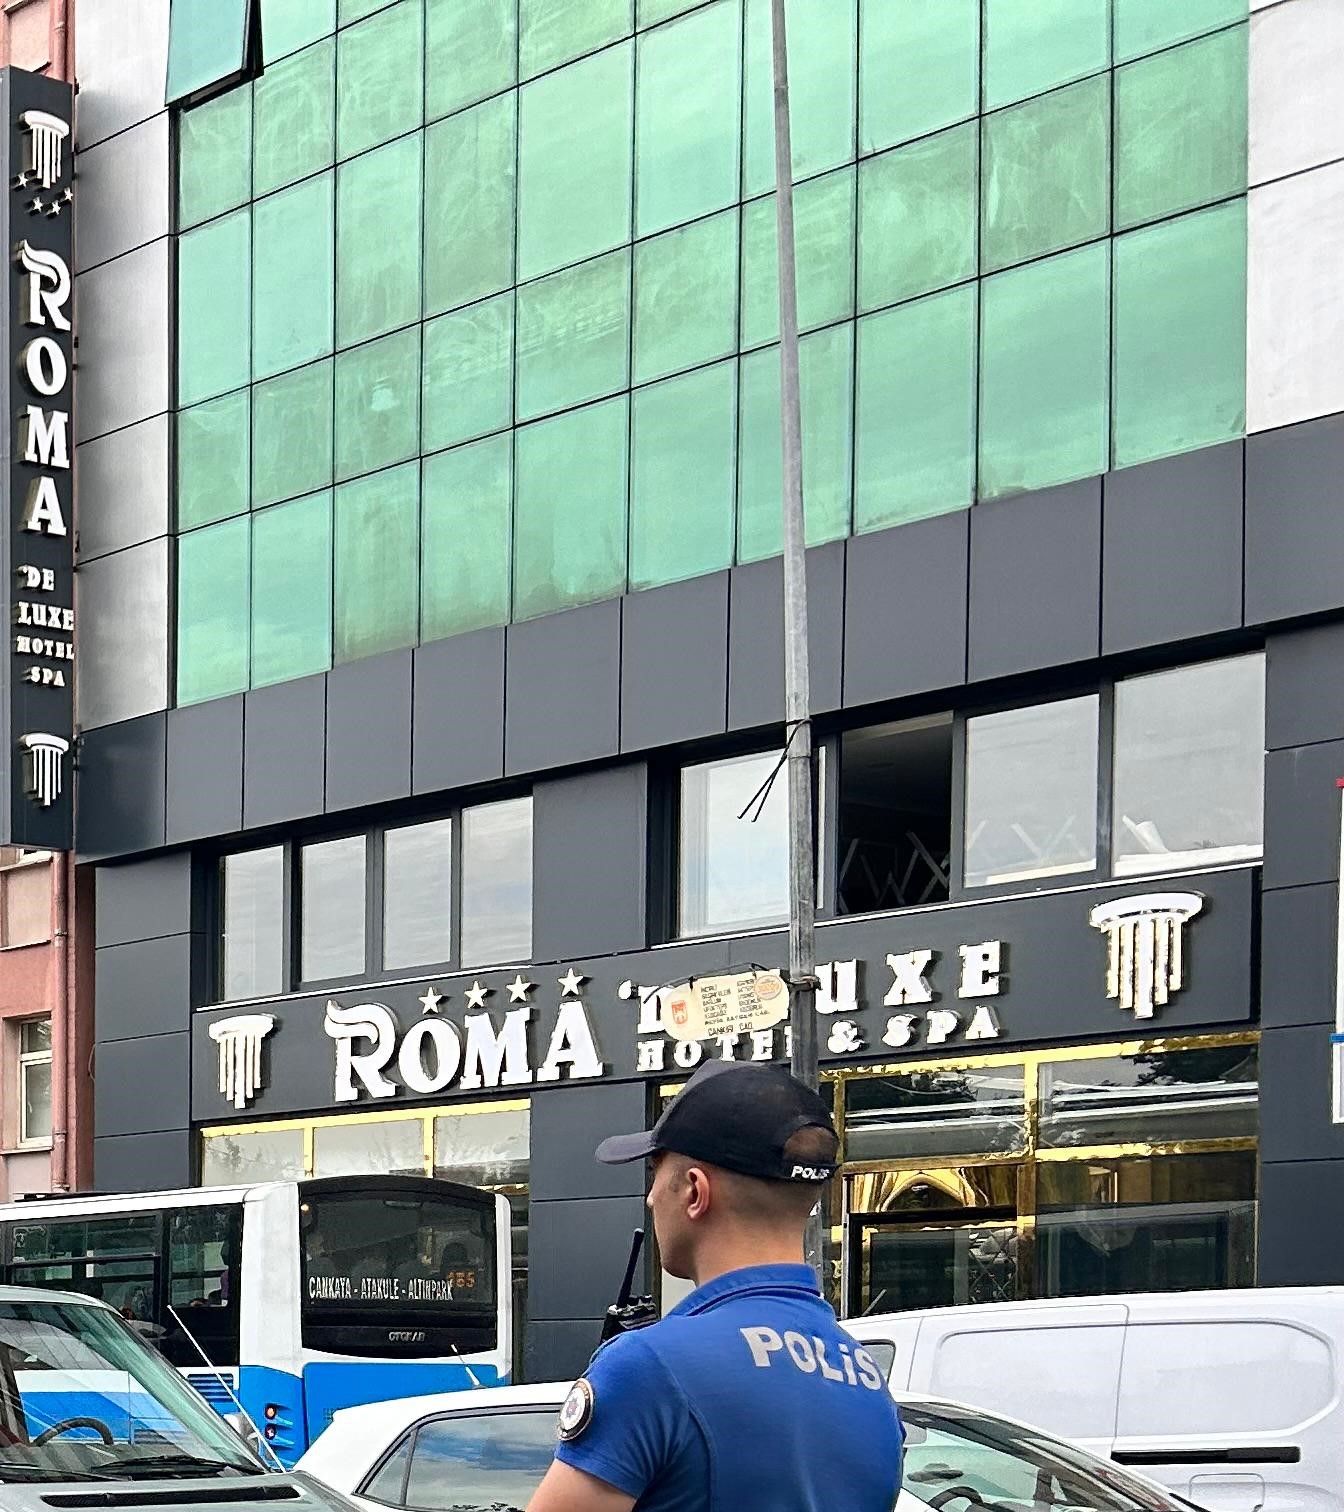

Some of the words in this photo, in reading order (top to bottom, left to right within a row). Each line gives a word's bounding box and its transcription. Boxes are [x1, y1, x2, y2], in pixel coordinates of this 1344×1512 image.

[21, 239, 72, 536] ROMA
[17, 601, 75, 631] LUXE
[16, 635, 75, 660] HOTEL
[29, 665, 66, 687] SPA
[881, 1004, 1002, 1048] SPA
[324, 1000, 606, 1102] ROMA
[361, 1277, 400, 1300] ATAKULE
